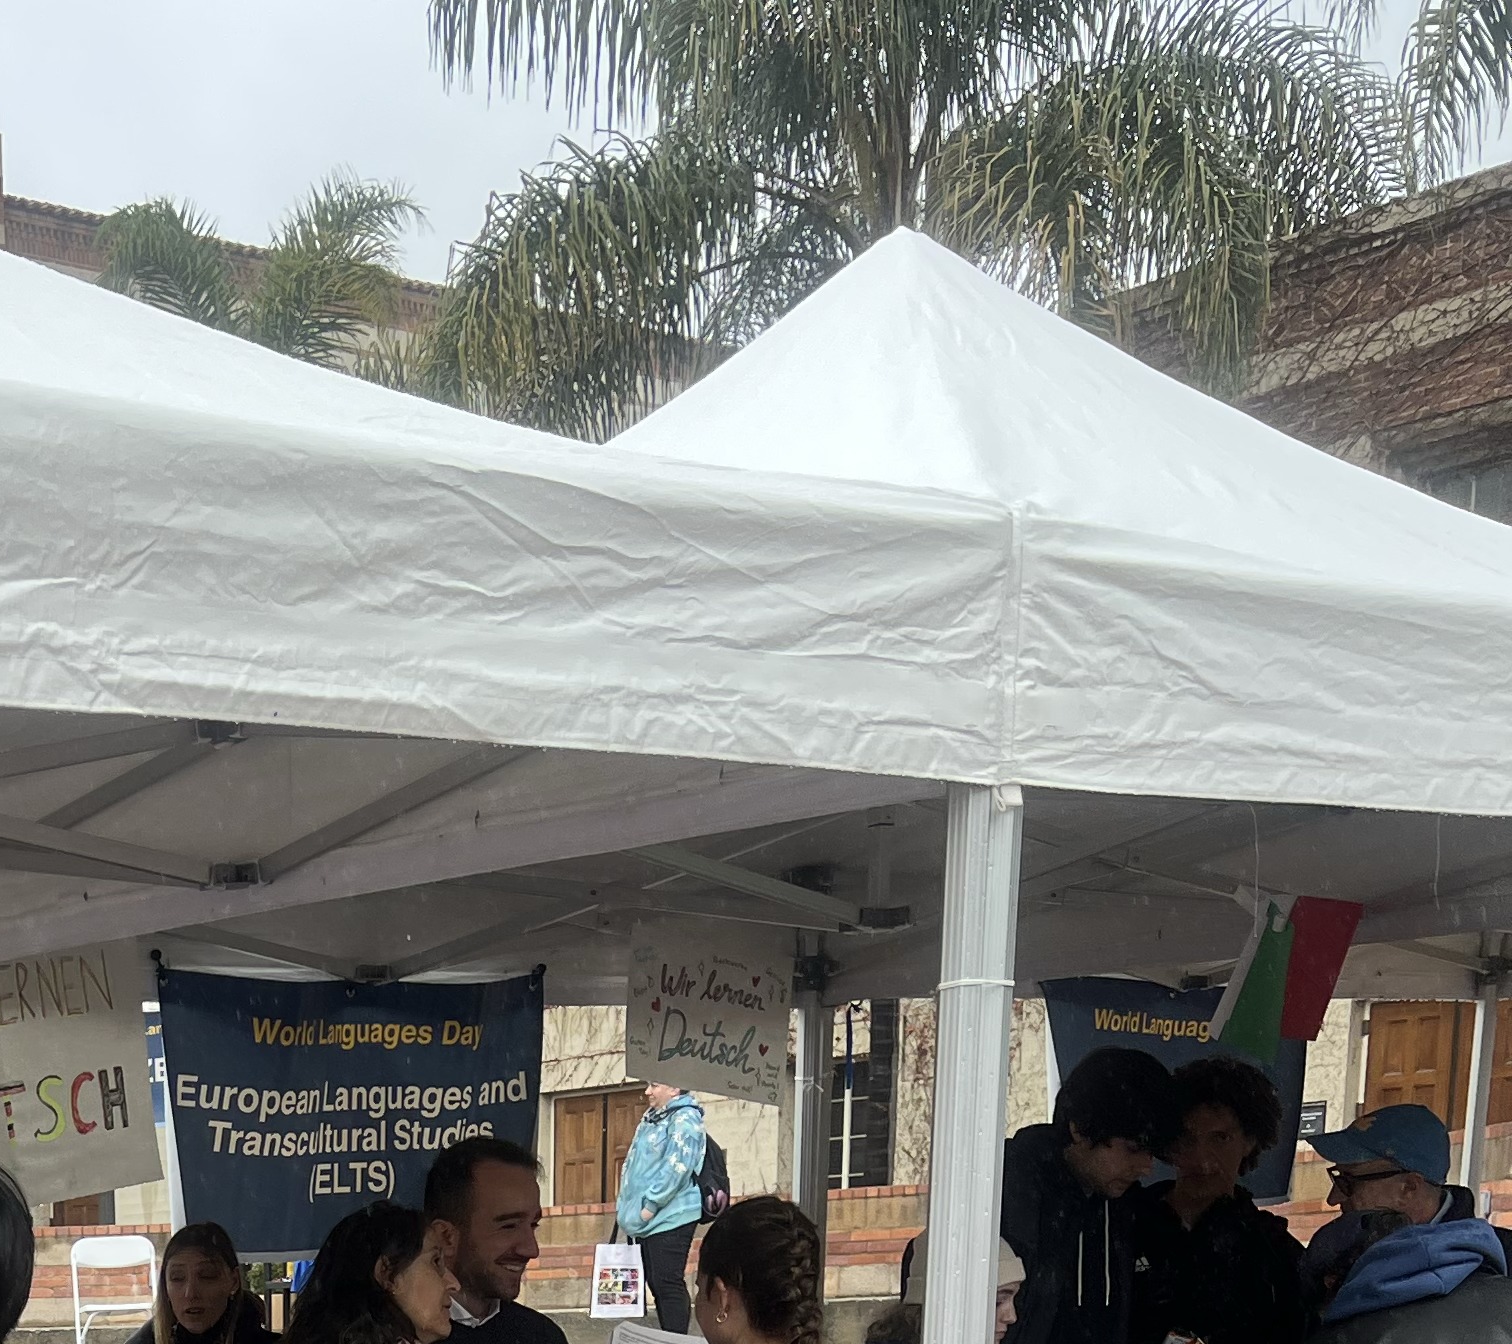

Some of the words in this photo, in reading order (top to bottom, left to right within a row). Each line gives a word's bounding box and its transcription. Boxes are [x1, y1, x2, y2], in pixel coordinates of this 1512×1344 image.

[661, 963, 696, 998] Wir
[700, 969, 766, 1012] lernen
[252, 1016, 315, 1047] World
[318, 1019, 433, 1051] Languages
[441, 1020, 484, 1051] Day
[658, 1006, 756, 1075] Deutsch
[1094, 1008, 1140, 1033] World
[1142, 1013, 1212, 1043] Languag
[176, 1073, 320, 1123] European
[322, 1080, 472, 1119] Languages
[478, 1070, 528, 1105] and
[208, 1120, 387, 1157] Transcultural
[309, 1160, 395, 1204] (ELTS)
